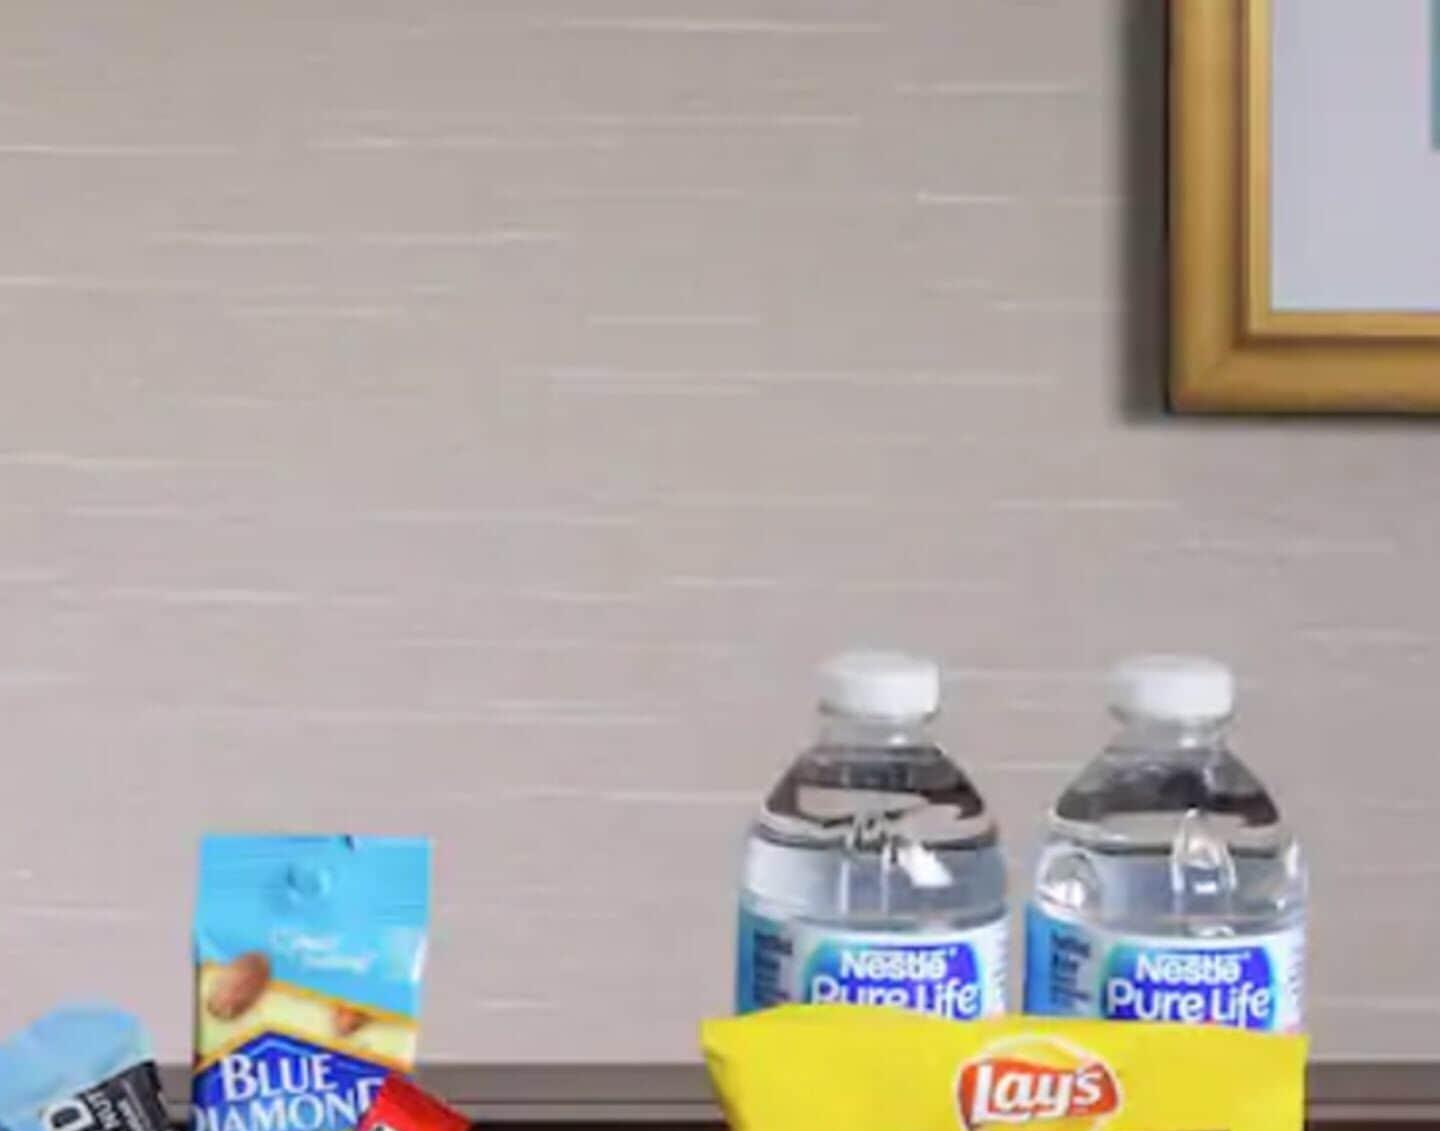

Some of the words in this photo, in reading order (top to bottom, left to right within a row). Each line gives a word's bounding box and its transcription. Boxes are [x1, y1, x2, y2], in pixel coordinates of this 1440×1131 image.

[917, 977, 978, 1018] Life
[1107, 977, 1205, 1022] Pure
[1211, 982, 1270, 1028] Life
[222, 1053, 338, 1101] BLUE
[970, 1063, 1102, 1125] Lay's
